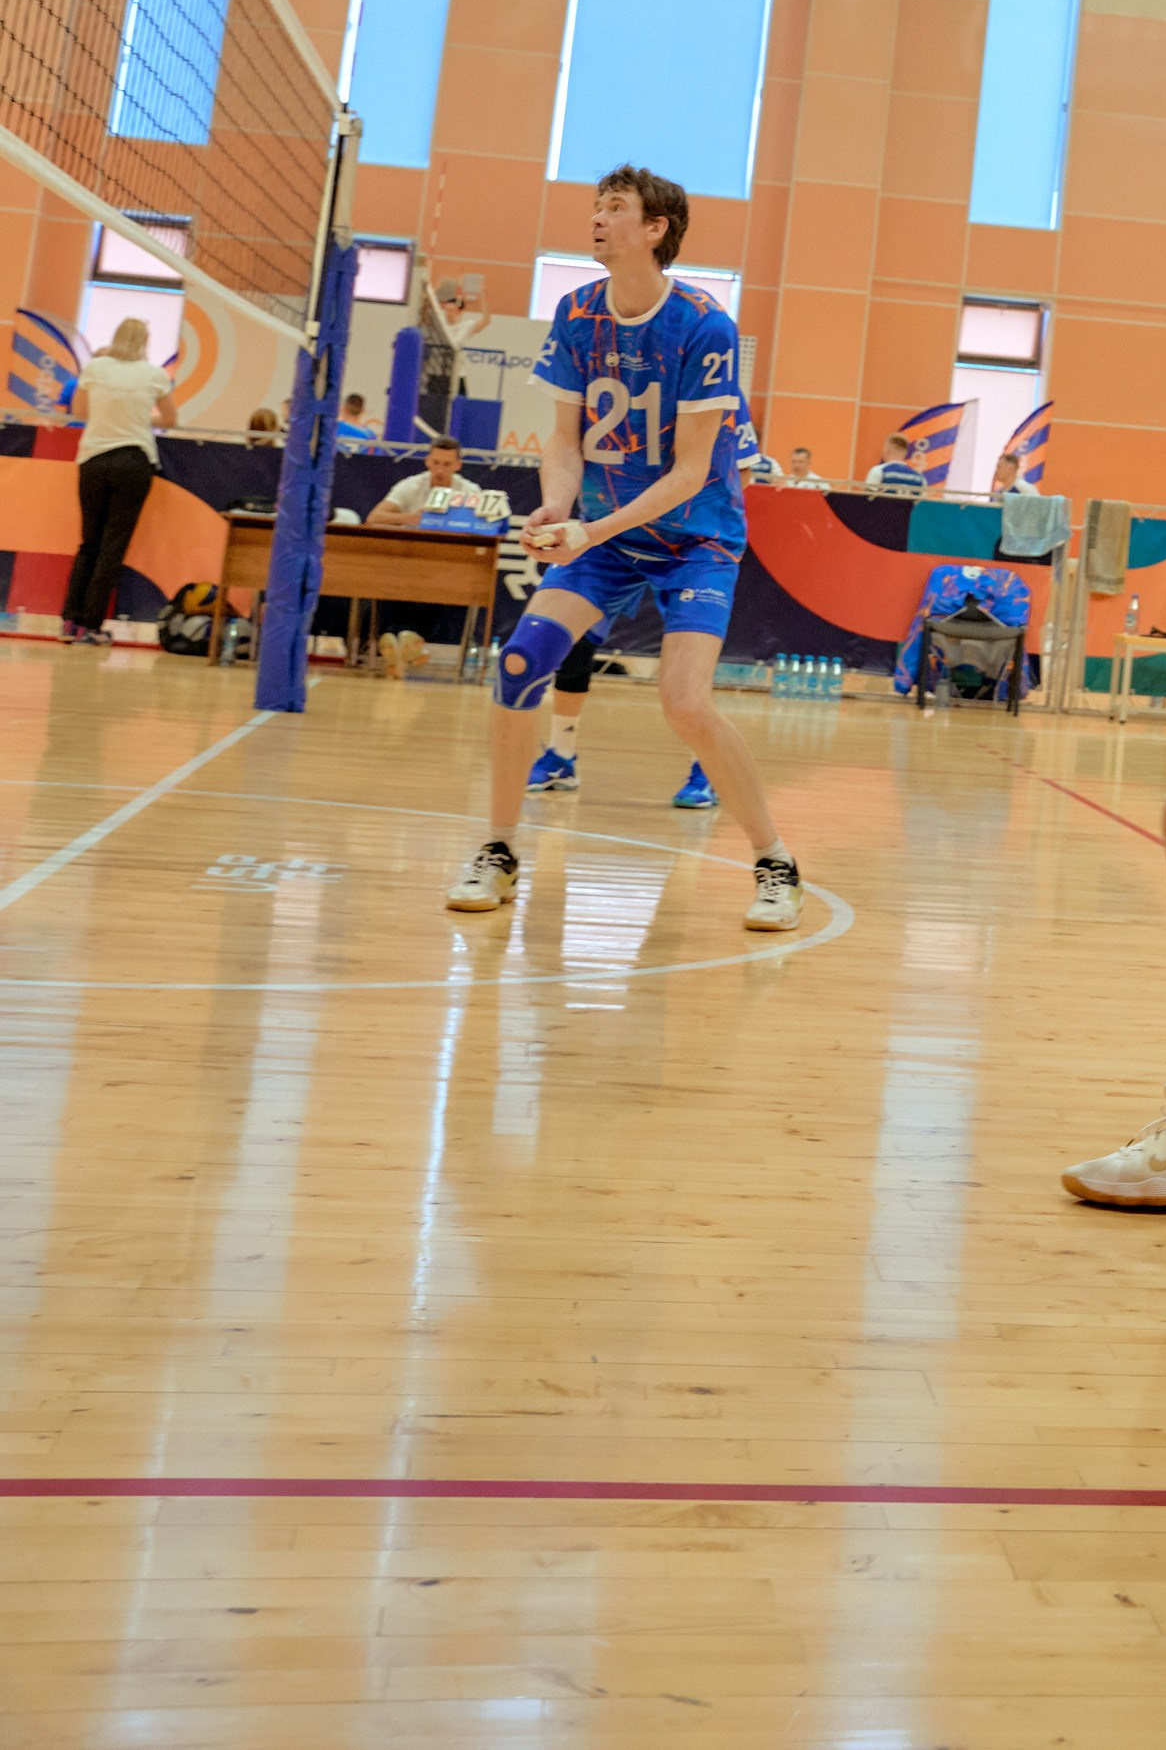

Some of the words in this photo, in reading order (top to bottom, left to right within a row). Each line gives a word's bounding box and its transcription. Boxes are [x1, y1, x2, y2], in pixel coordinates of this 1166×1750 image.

[702, 348, 734, 387] 21
[582, 376, 662, 466] 21
[481, 495, 501, 512] 17
